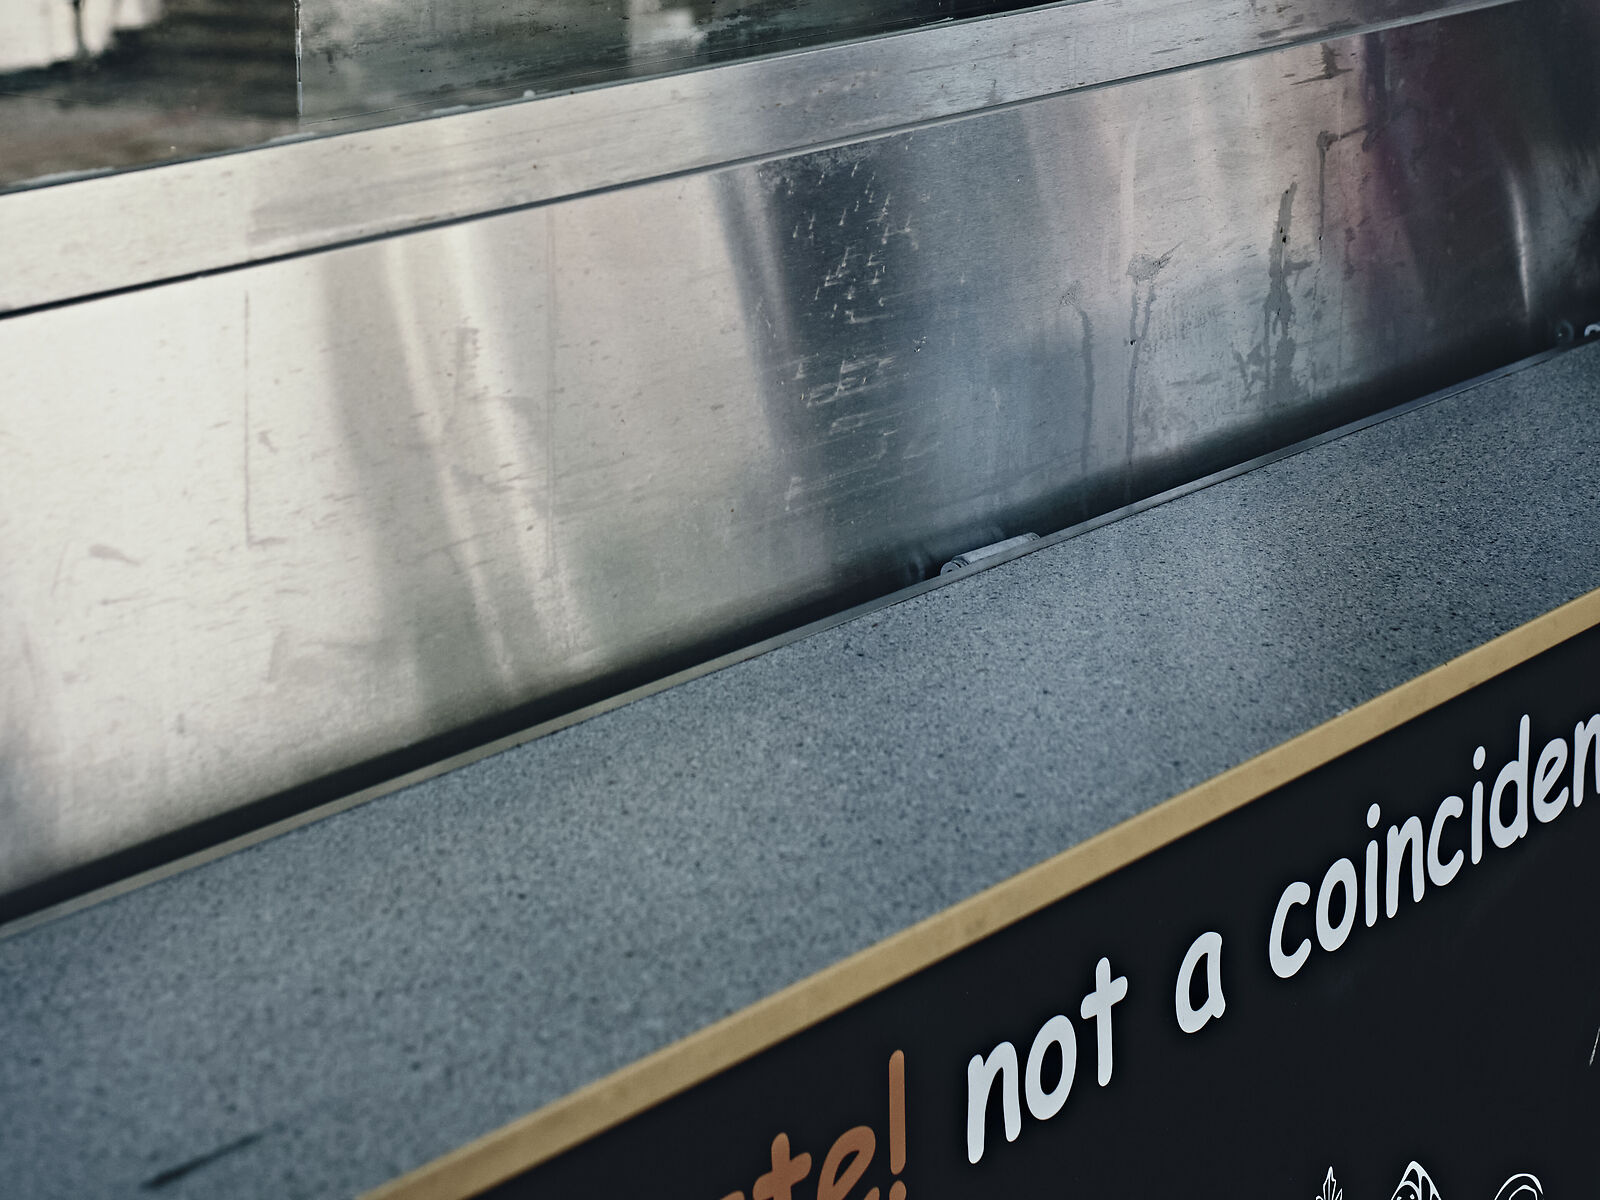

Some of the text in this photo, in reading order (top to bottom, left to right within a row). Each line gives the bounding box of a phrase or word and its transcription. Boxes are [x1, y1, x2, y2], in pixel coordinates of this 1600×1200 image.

[966, 956, 1129, 1165] not
[1175, 931, 1227, 1034] a
[1268, 713, 1600, 979] coinciden
